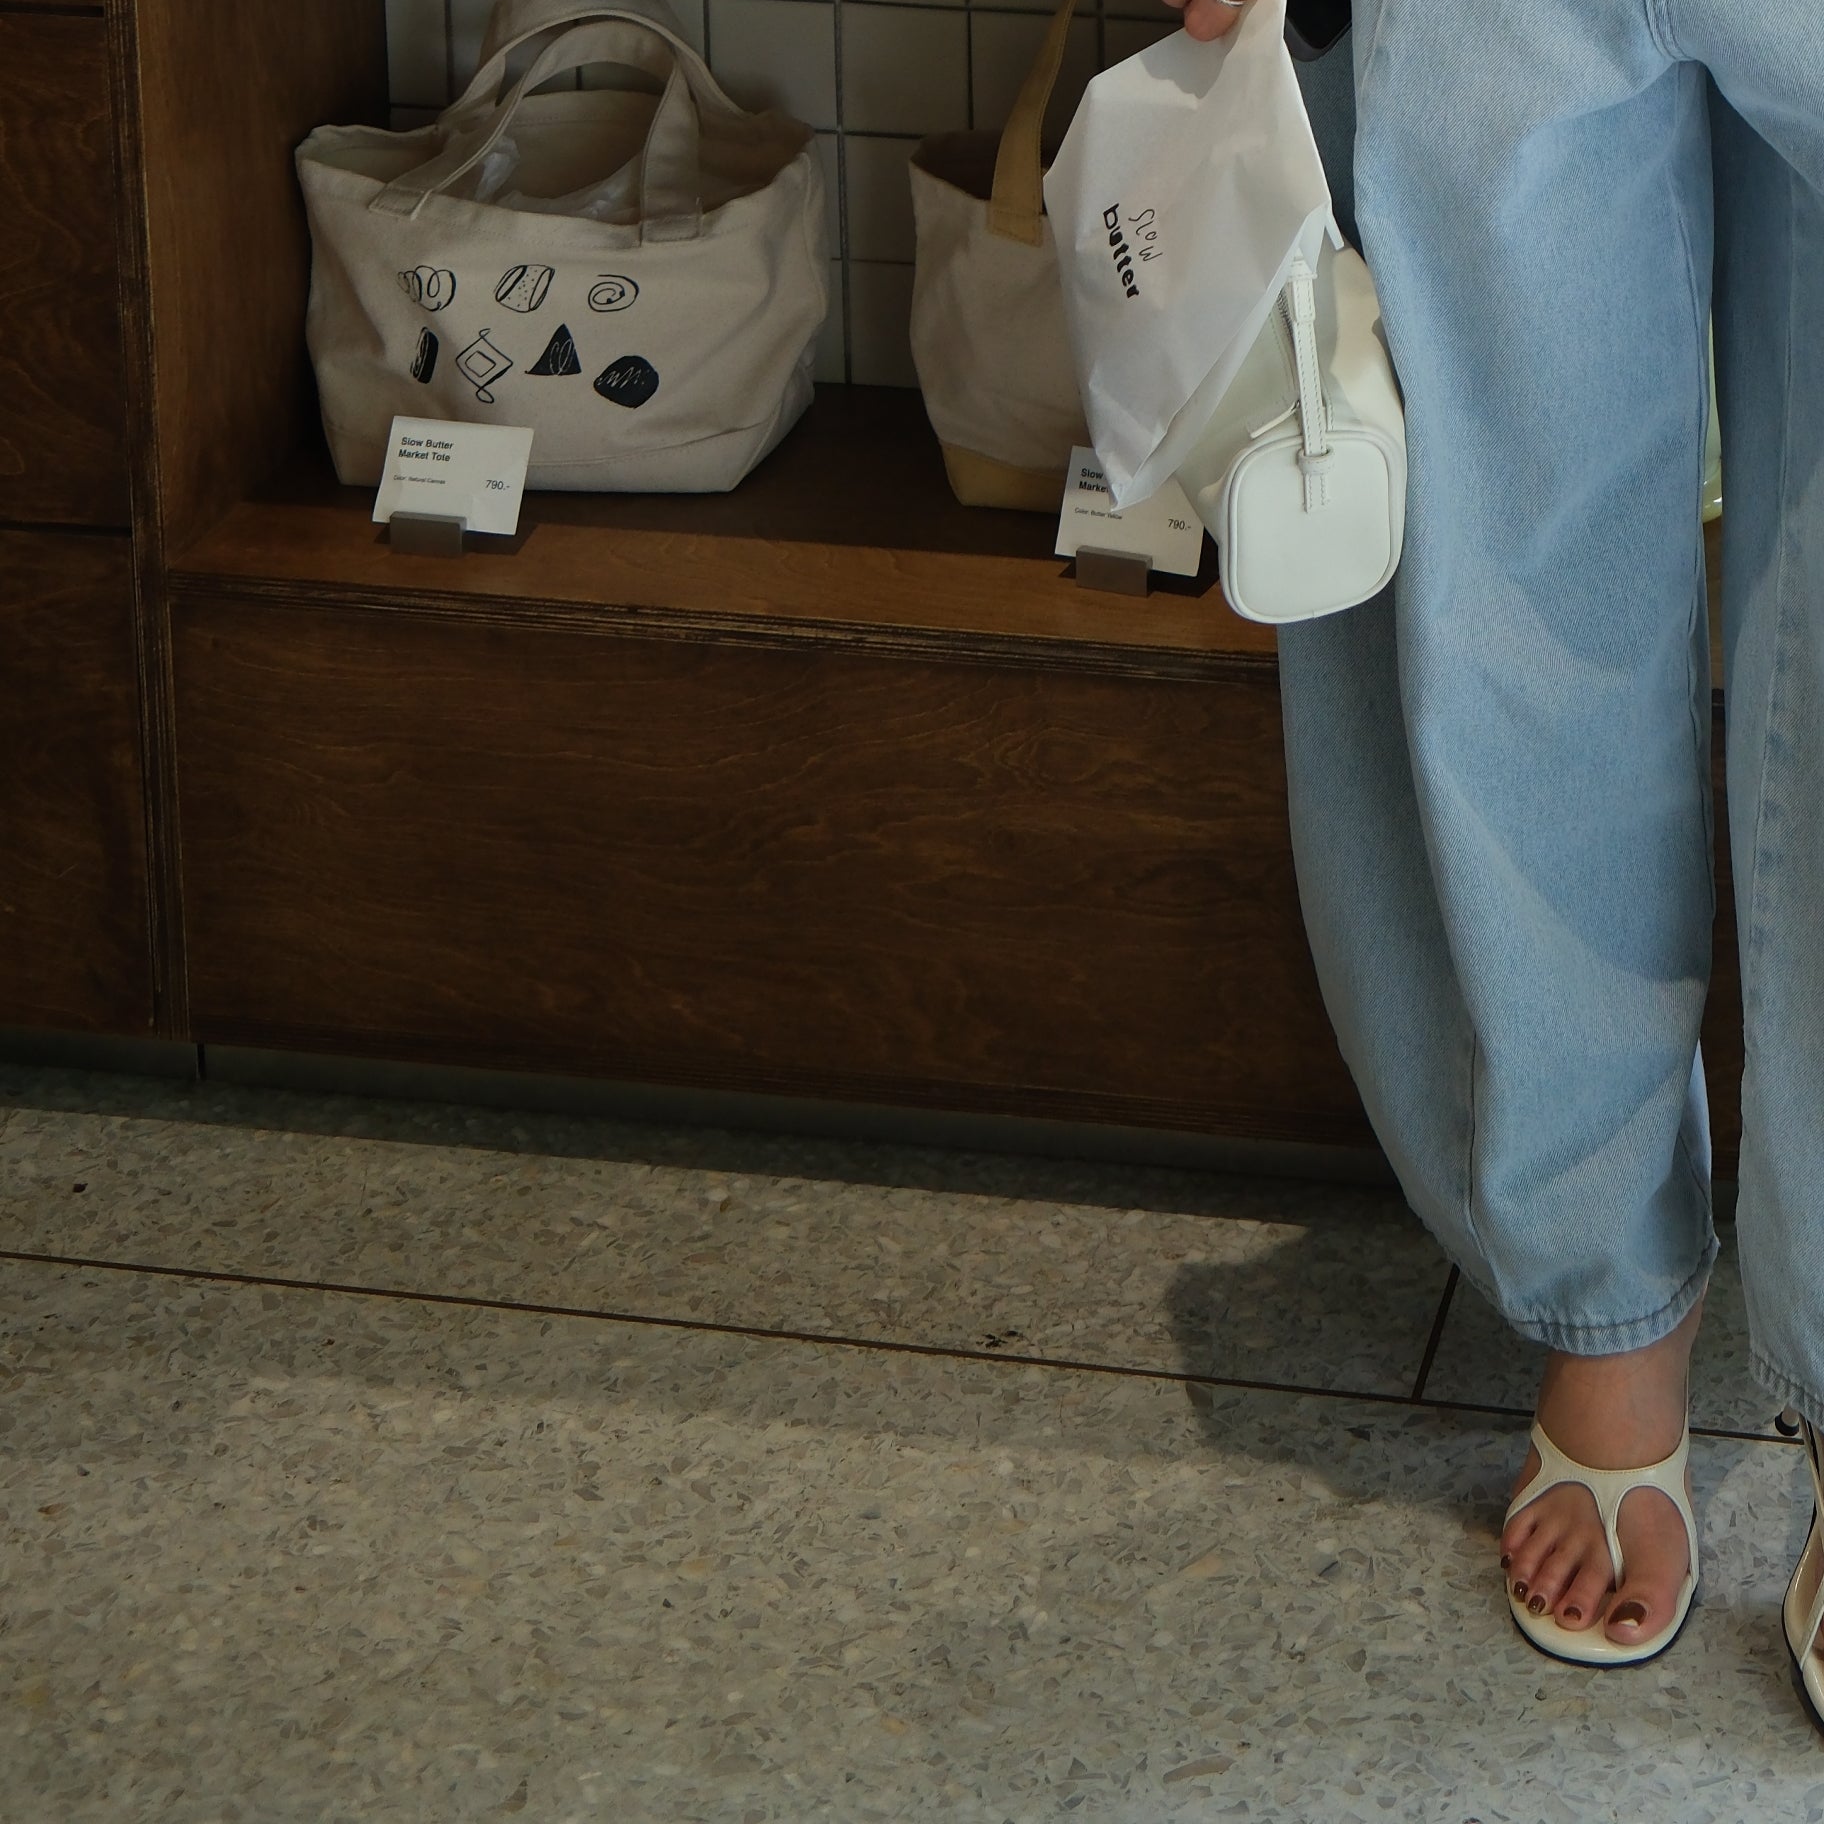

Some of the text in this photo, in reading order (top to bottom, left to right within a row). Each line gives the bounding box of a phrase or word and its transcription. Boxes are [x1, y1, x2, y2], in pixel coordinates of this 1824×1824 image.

[1103, 203, 1140, 299] butter
[401, 437, 454, 450] Slow Butter
[398, 449, 451, 462] Market Tote
[1081, 468, 1104, 480] Slow
[485, 479, 510, 491] 790.-
[1167, 518, 1192, 531] 790.-
